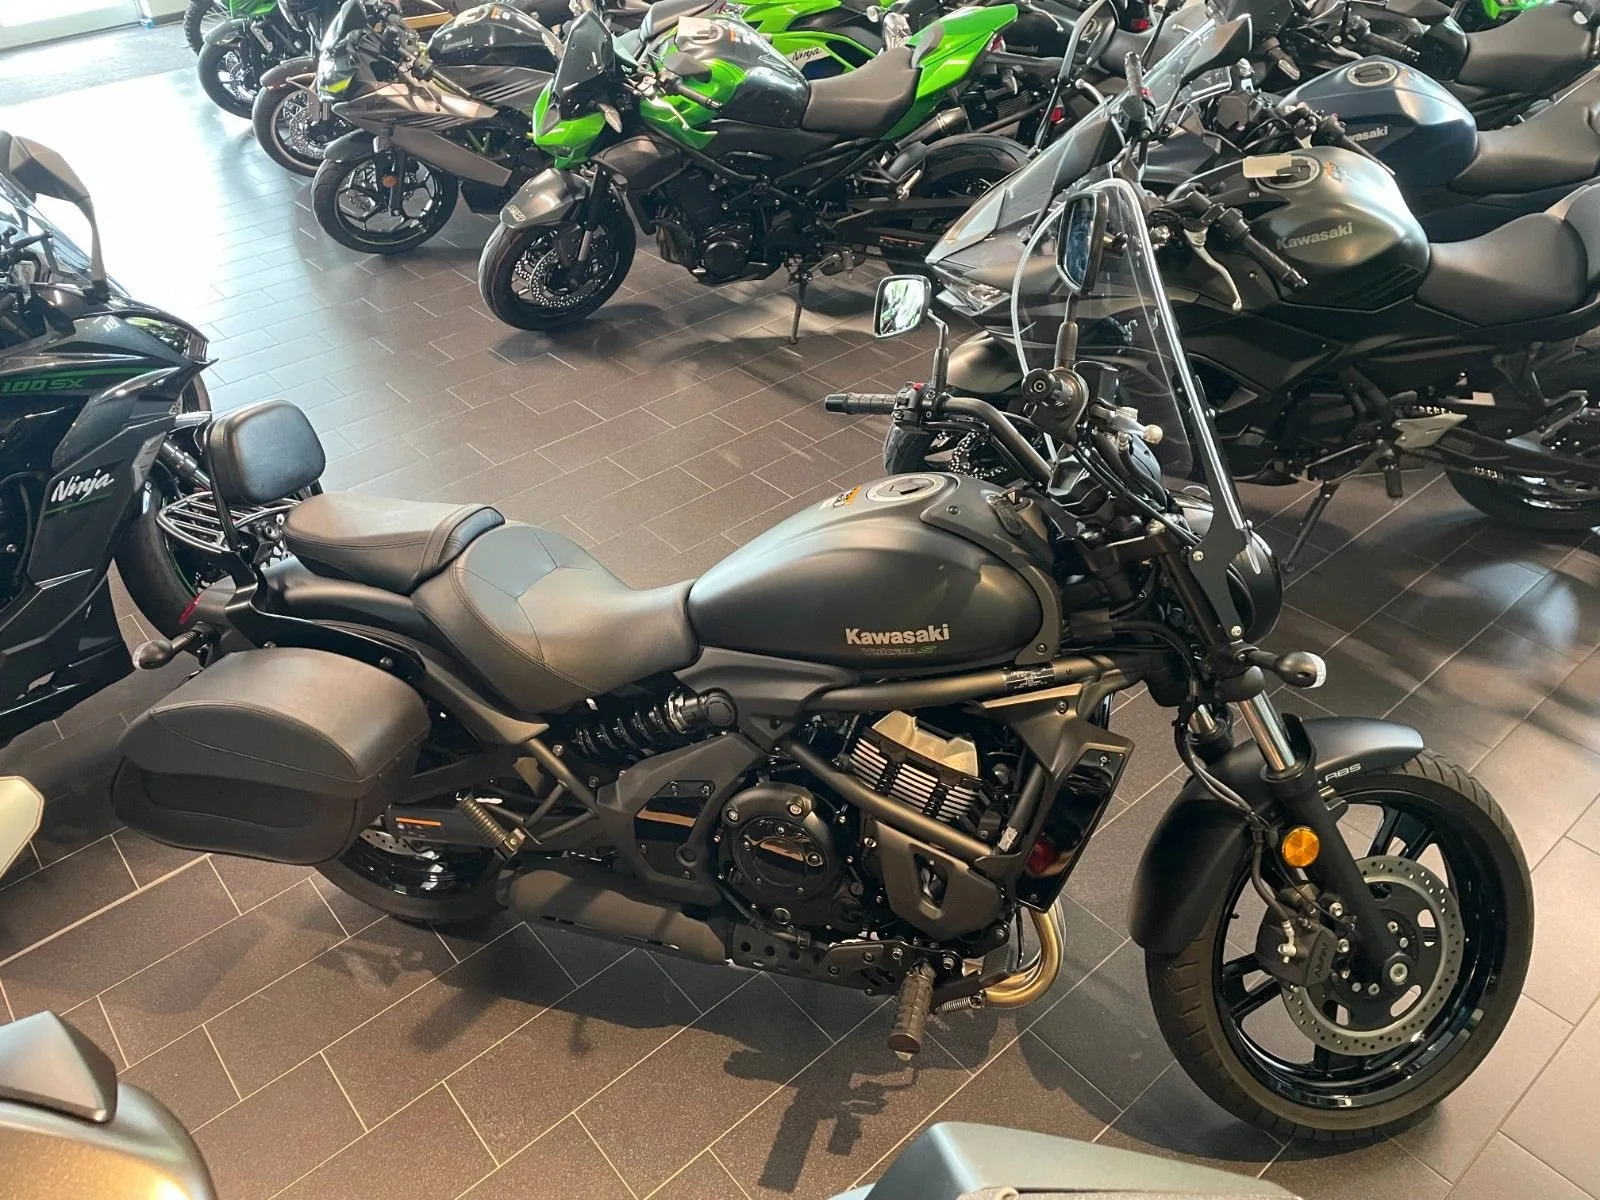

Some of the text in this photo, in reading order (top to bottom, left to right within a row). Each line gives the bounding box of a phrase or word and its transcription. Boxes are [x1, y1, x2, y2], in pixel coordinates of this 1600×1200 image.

[792, 47, 822, 61] Ninja
[1276, 222, 1353, 249] Kawasaki
[51, 469, 115, 502] Ninja
[845, 623, 950, 645] Kawasaki
[1325, 763, 1361, 782] ABS
